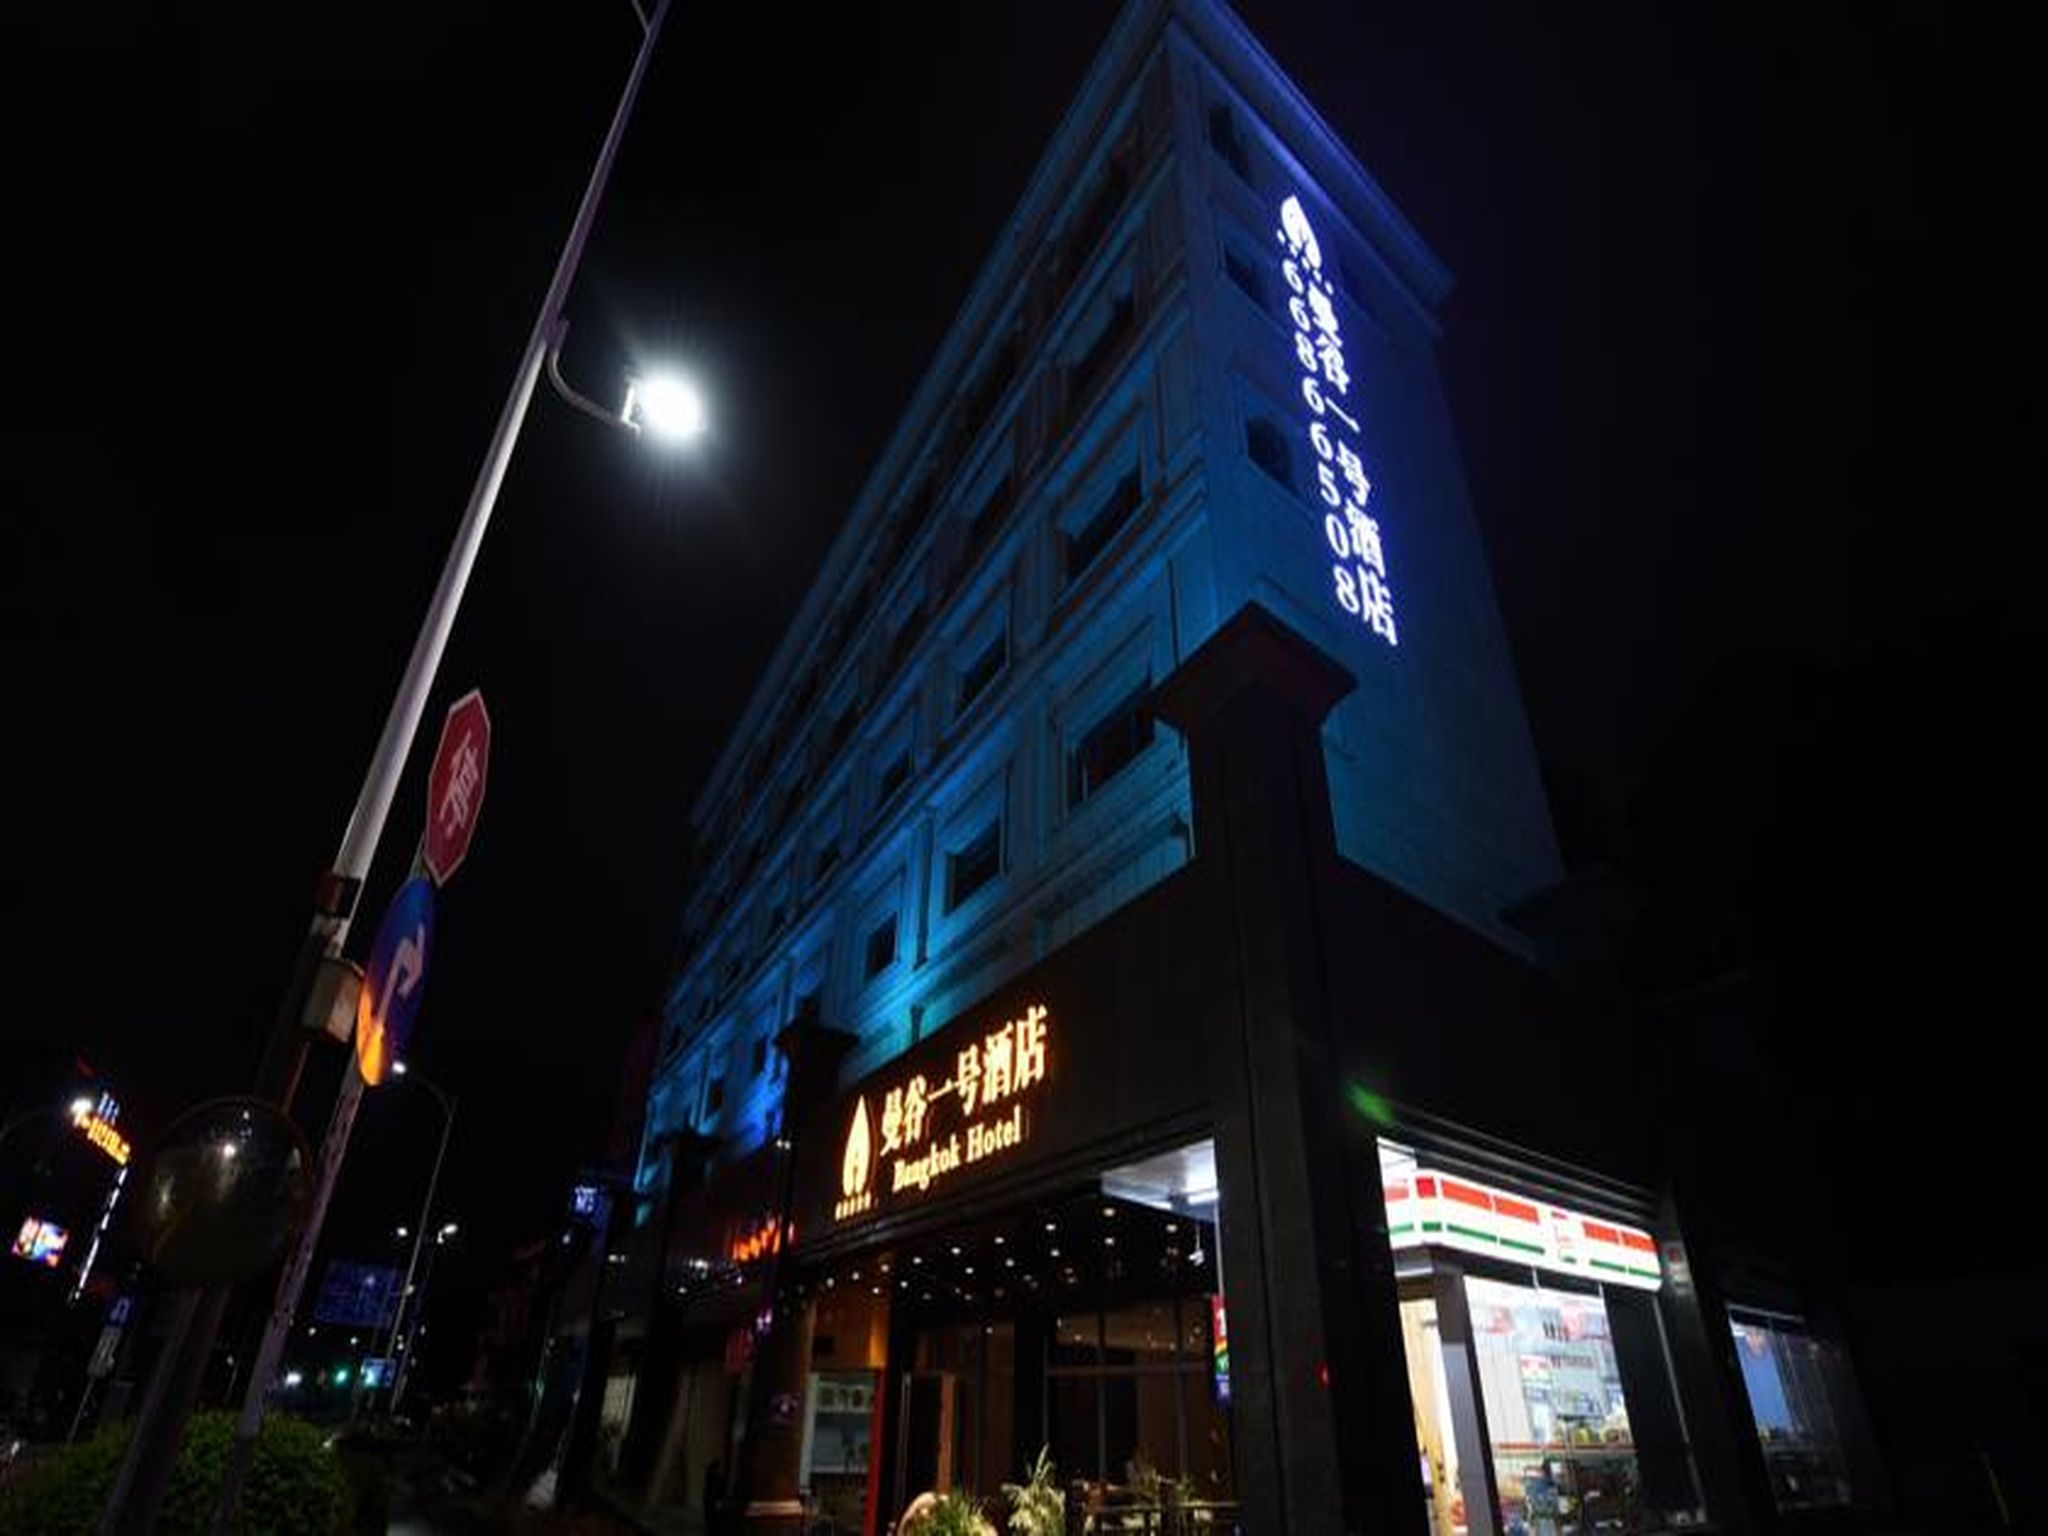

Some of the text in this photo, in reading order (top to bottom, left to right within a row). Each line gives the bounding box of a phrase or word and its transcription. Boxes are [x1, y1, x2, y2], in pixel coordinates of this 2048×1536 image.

[1283, 259, 1360, 614] 66866508
[1307, 280, 1397, 646] 曼谷一号酒店
[439, 729, 478, 838] 停
[880, 1004, 1047, 1156] 曼谷一号酒店
[893, 1104, 1021, 1192] Bangkok Hotel
